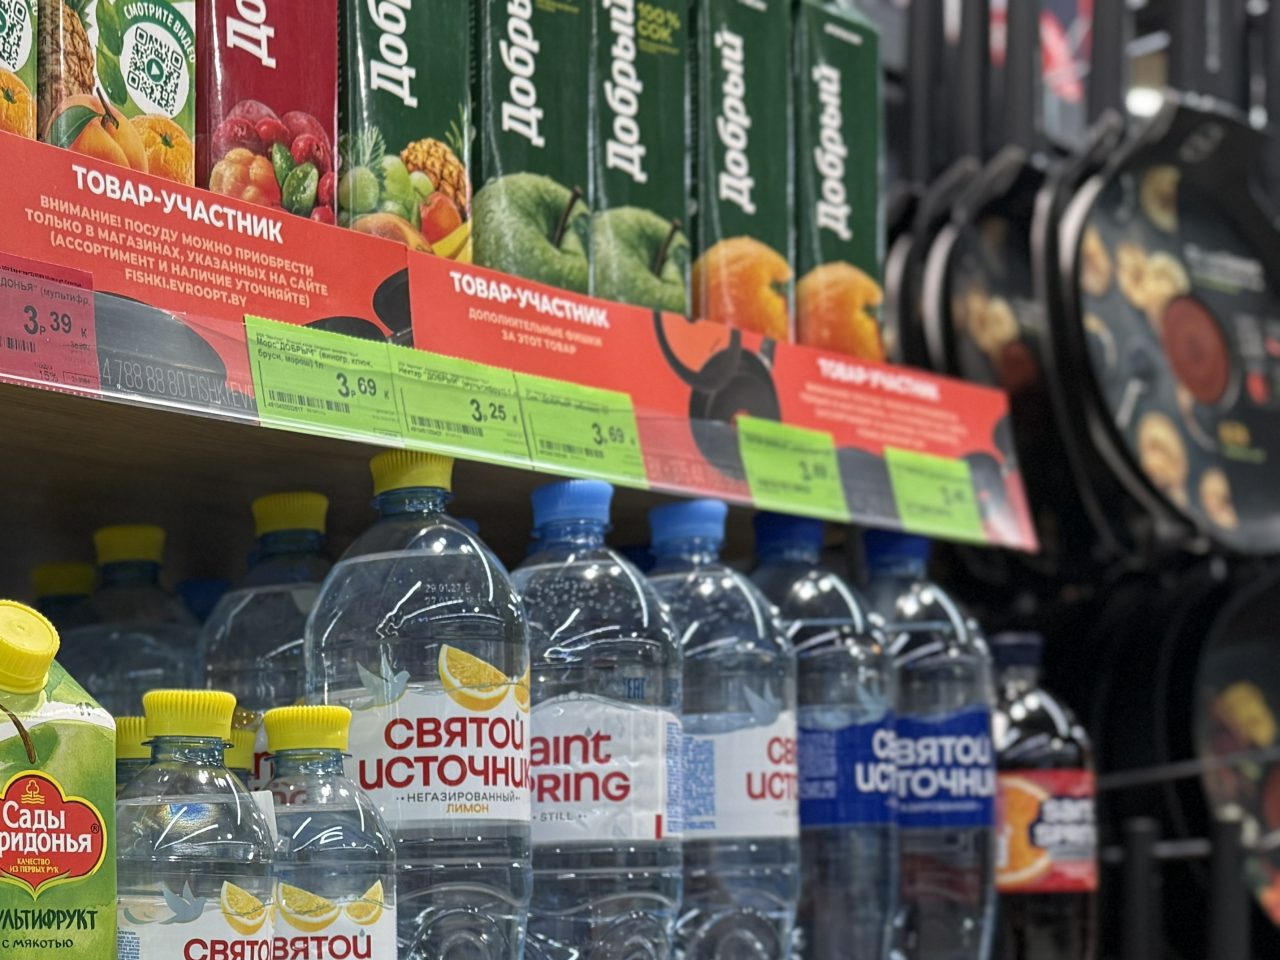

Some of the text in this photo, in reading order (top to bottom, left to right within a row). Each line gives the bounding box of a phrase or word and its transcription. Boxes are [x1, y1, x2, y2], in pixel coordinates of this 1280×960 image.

[715, 28, 756, 215] Добрый
[812, 62, 853, 241] Добрый
[71, 164, 283, 244] ТОВАР-УЧАСТНИК
[25, 208, 328, 296] ТОЛЬКО В МАГАЗИНАХ, УКАЗАННЫХ НА САЙТЕ
[40, 195, 314, 277] ВНИМАНИЕ! ПОСУДУ МОЖНО ПРИОБРЕСТИ
[50, 230, 310, 309] (АССОРТИМЕНТ И НАЛИЧИЕ УТОЧНЯЙТЕ)
[124, 268, 247, 308] FISHKI.EVROOPT.BY
[24, 305, 72, 335] 3 39
[449, 271, 610, 329] ТОВАР-УЧАСТНИК
[336, 372, 350, 398] 3
[358, 377, 377, 396] 69
[470, 398, 507, 423] 3 25
[591, 423, 603, 447] 3
[2, 800, 66, 831] Сады
[445, 803, 489, 813] ЛИМОН
[16, 858, 51, 866] КАЧЕСТВО
